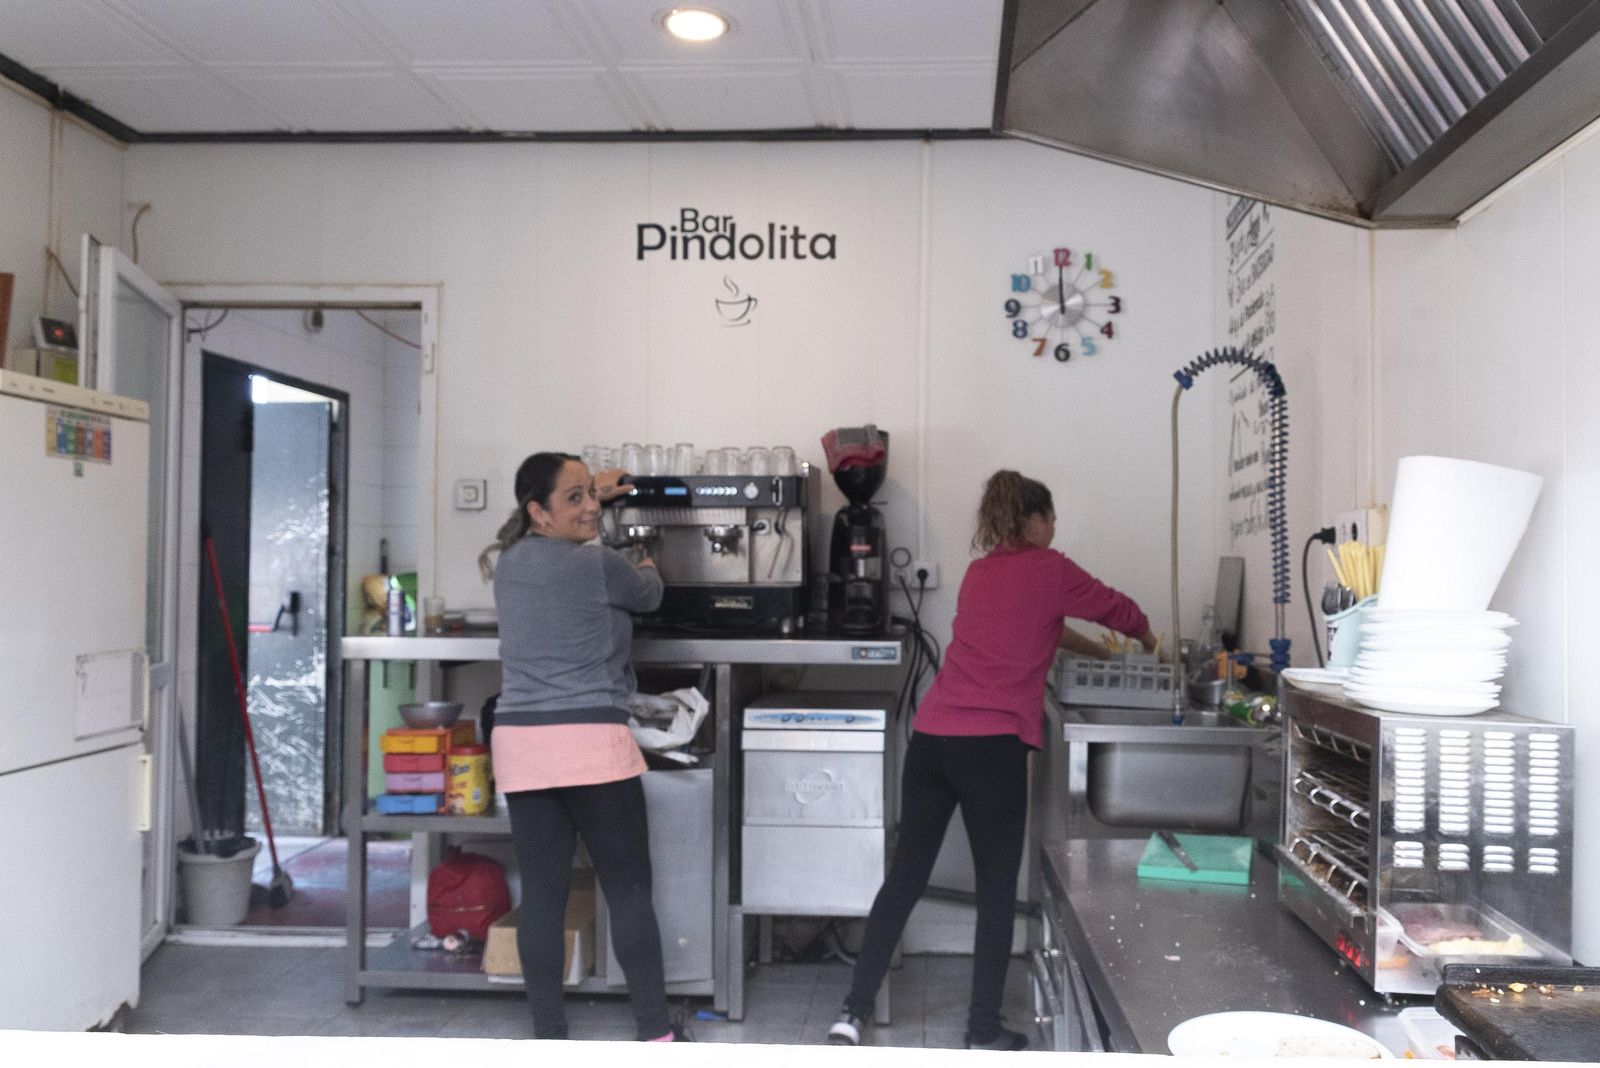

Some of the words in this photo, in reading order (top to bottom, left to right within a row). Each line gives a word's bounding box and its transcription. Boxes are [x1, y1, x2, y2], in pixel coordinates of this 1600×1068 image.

[680, 208, 734, 233] Bar
[637, 222, 837, 260] Pindolita
[1053, 247, 1071, 266] 12
[1085, 253, 1093, 271] 1
[1011, 273, 1031, 292] 10
[1099, 269, 1113, 288] 2
[1004, 298, 1021, 318] 9
[1108, 296, 1121, 314] 3
[1012, 320, 1028, 338] 8
[1100, 321, 1114, 339] 4
[1032, 337, 1047, 357] 7
[1054, 343, 1071, 362] 6
[1081, 337, 1097, 356] 5
